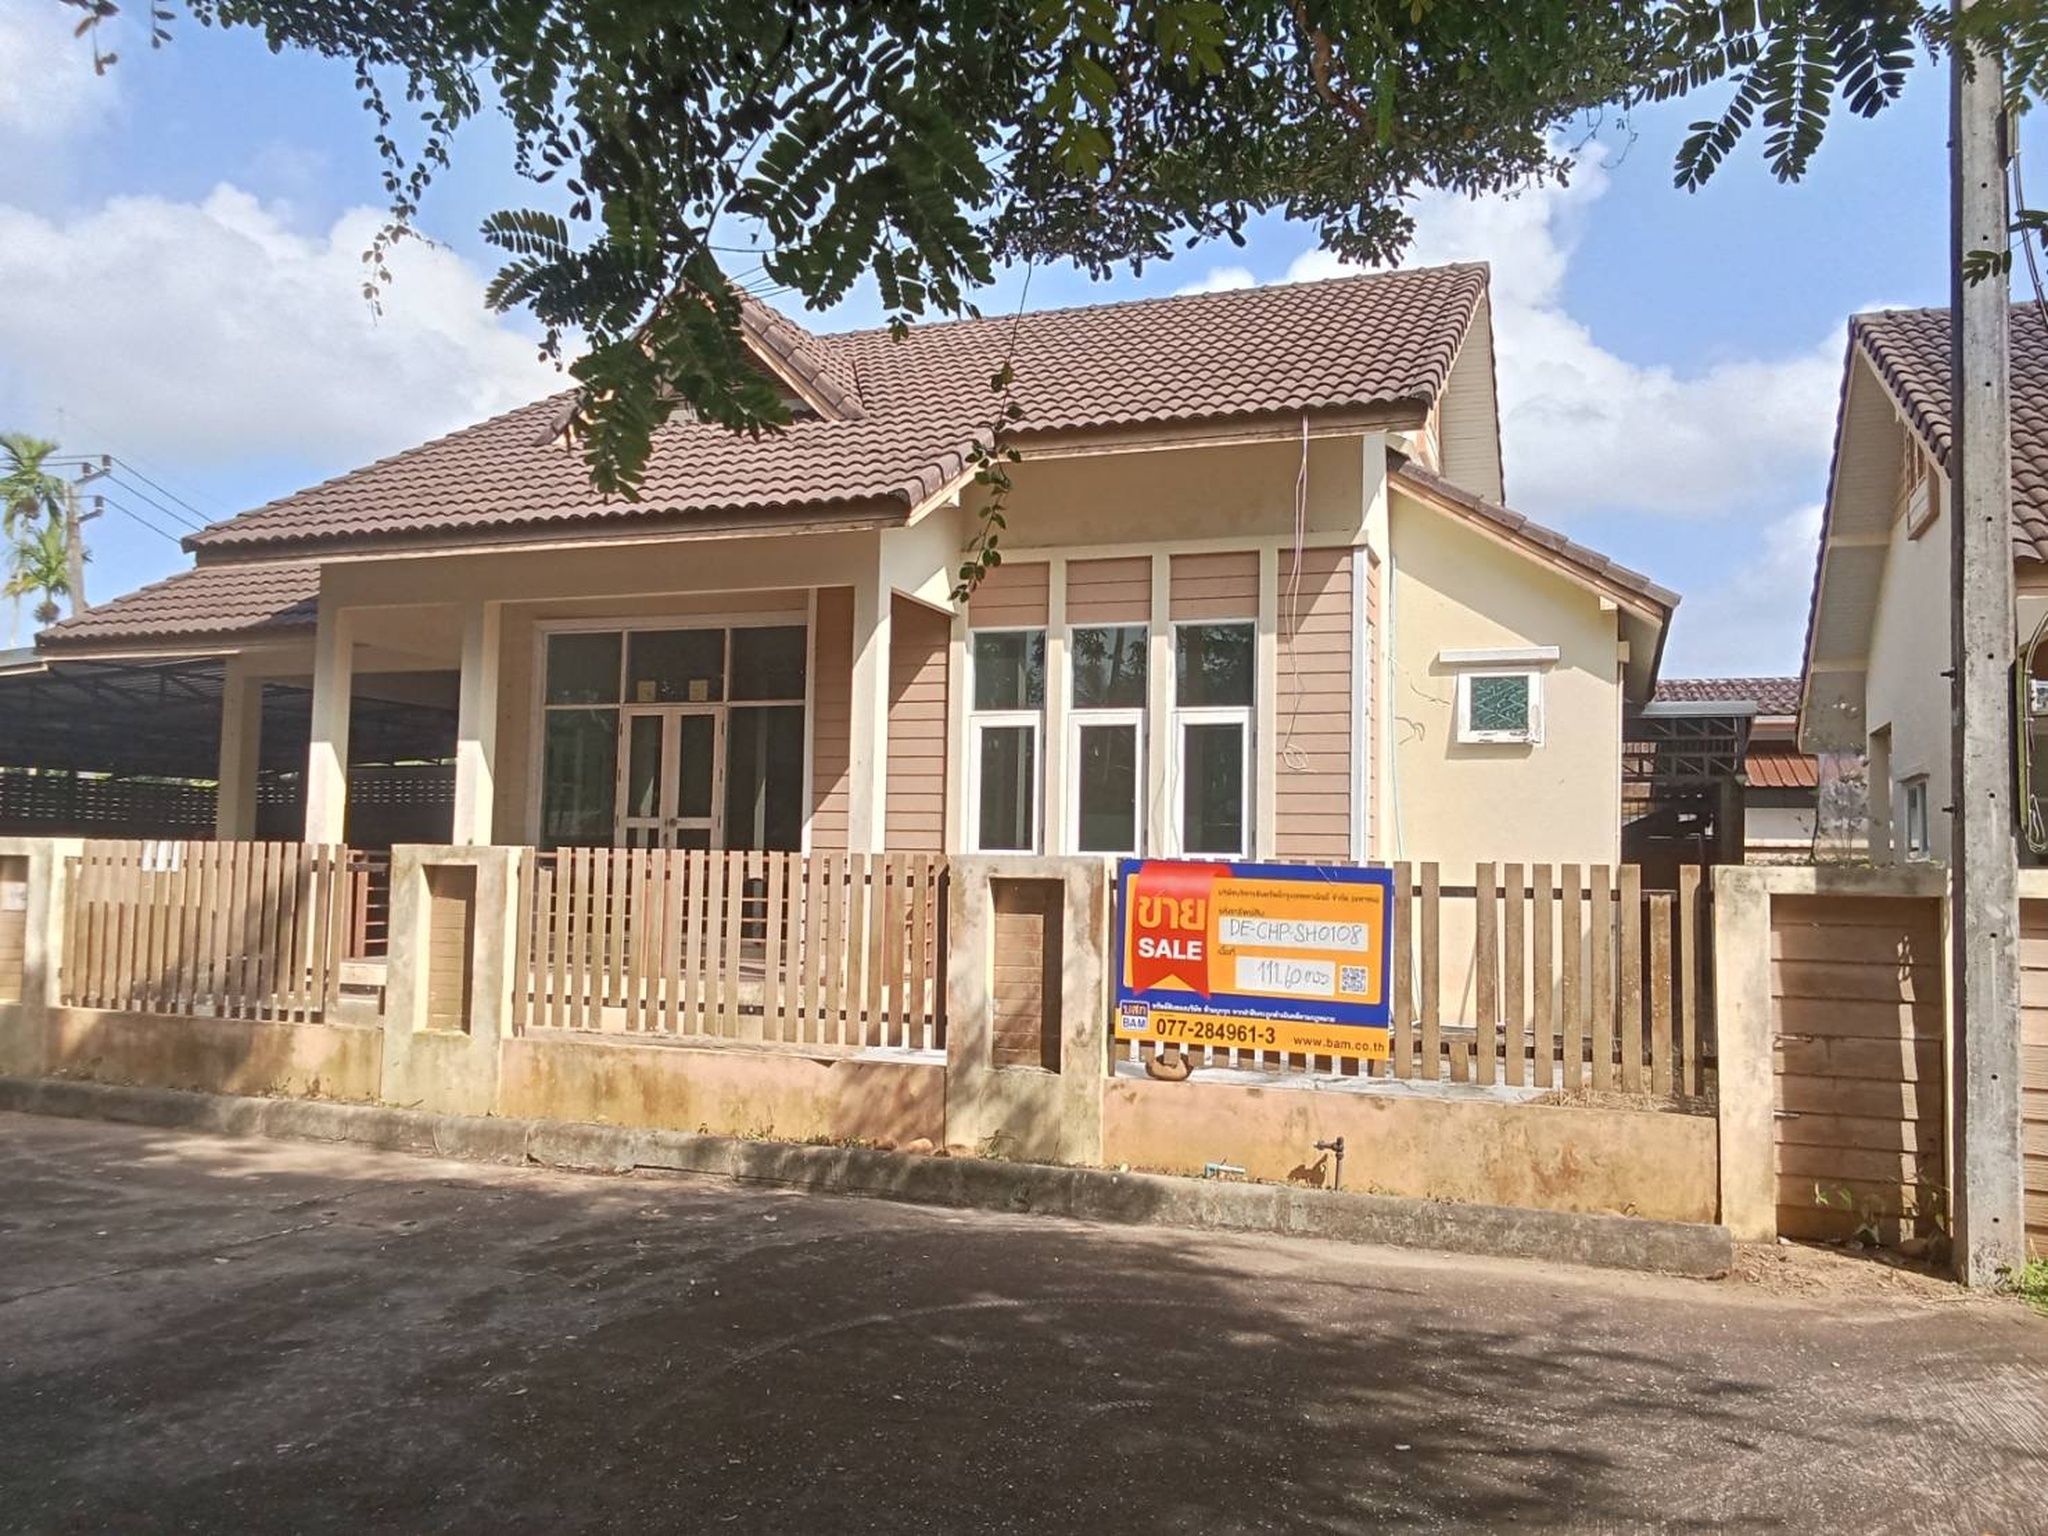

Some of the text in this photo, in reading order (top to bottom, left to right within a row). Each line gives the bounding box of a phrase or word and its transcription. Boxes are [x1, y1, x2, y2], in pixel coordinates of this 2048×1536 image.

[1138, 896, 1206, 931] ขาย
[1138, 937, 1203, 961] SALE
[1122, 1017, 1146, 1028] BAM
[1156, 1018, 1385, 1052] 077-284961-3 www.bam.co.th
